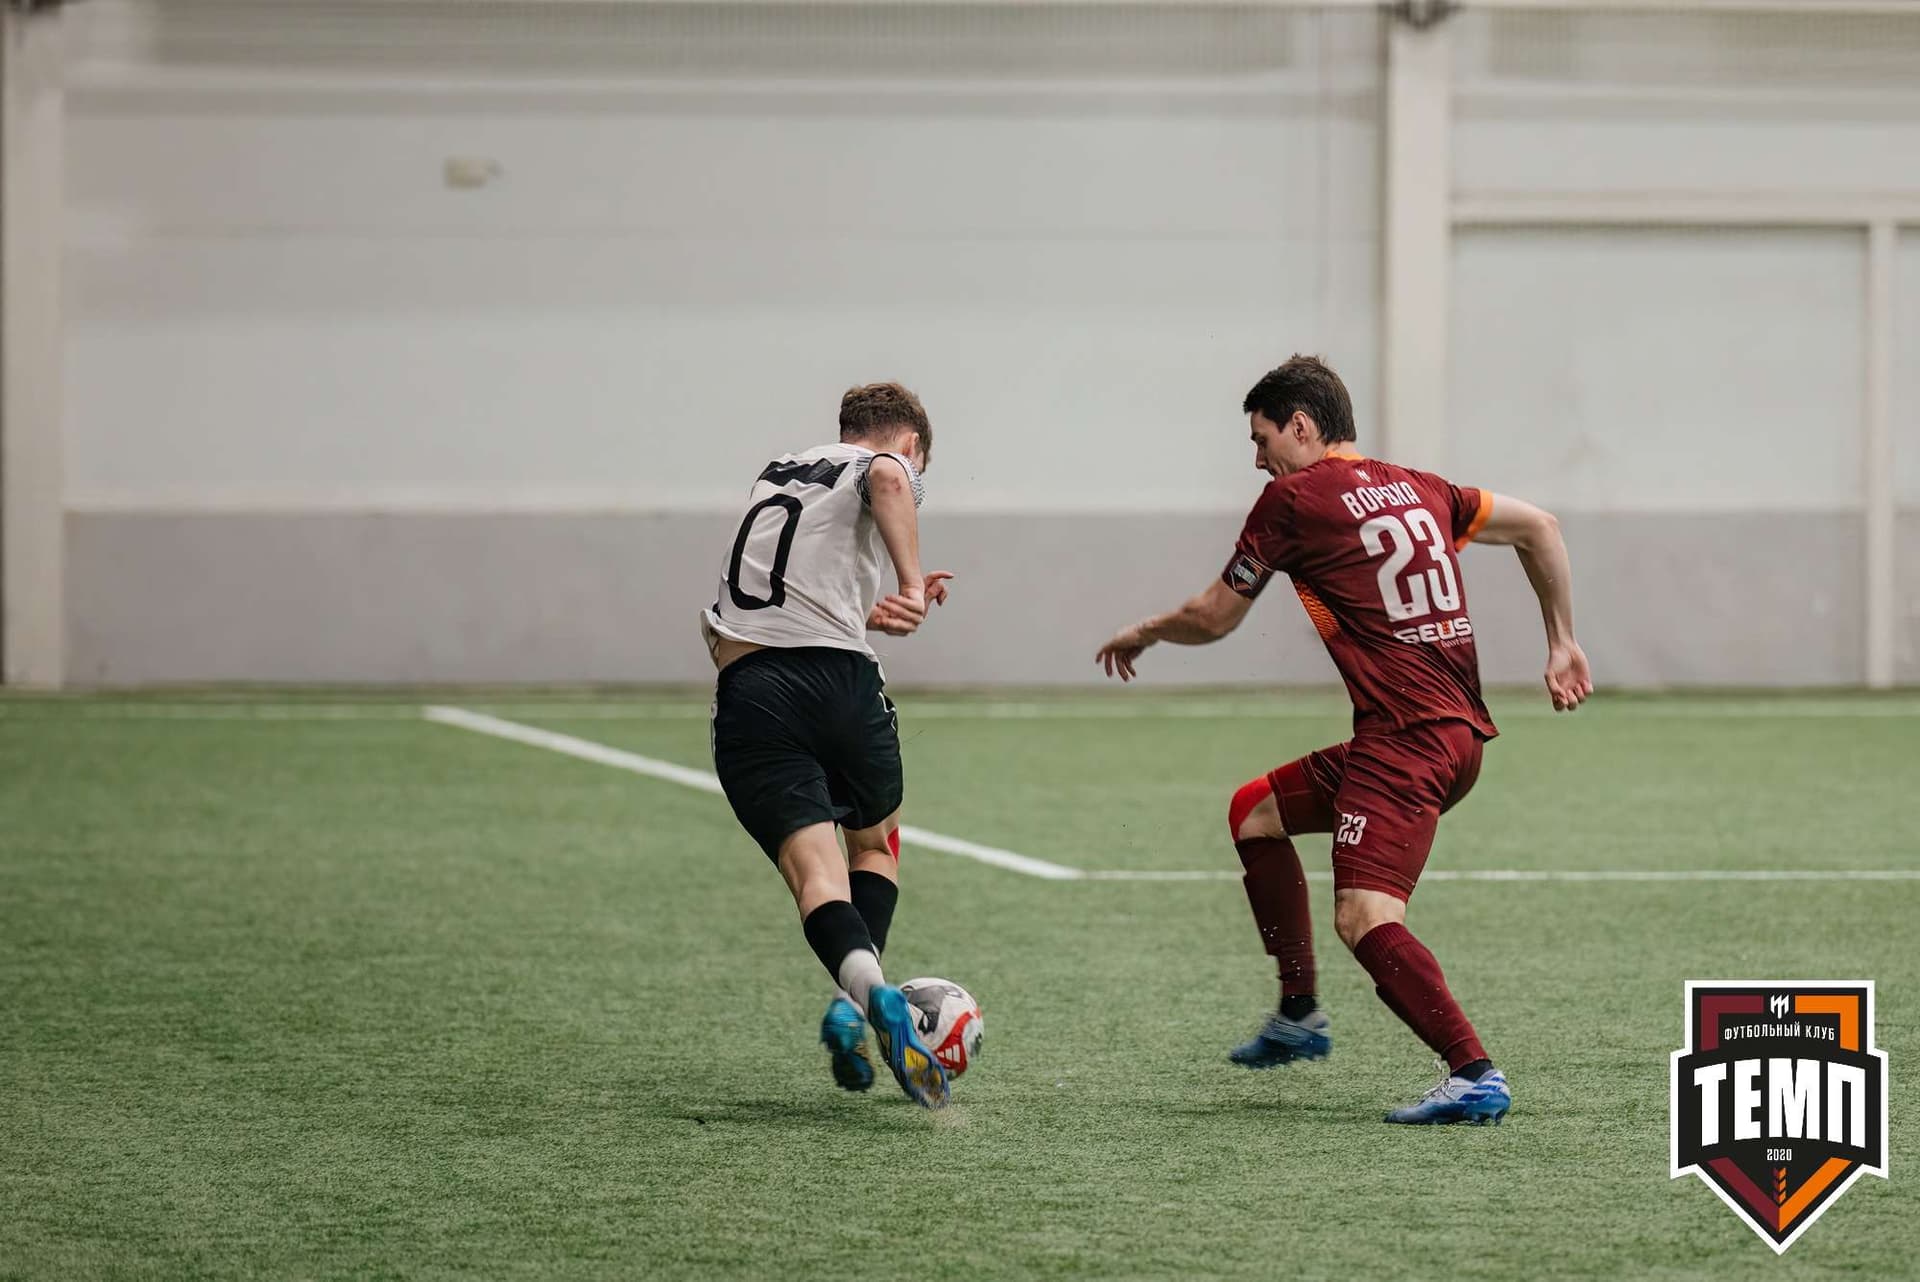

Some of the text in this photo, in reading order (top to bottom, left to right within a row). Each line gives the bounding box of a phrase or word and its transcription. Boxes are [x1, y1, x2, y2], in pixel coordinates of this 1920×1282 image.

[1359, 508, 1461, 622] 23
[1393, 617, 1473, 645] SEUS
[1337, 813, 1367, 845] 23
